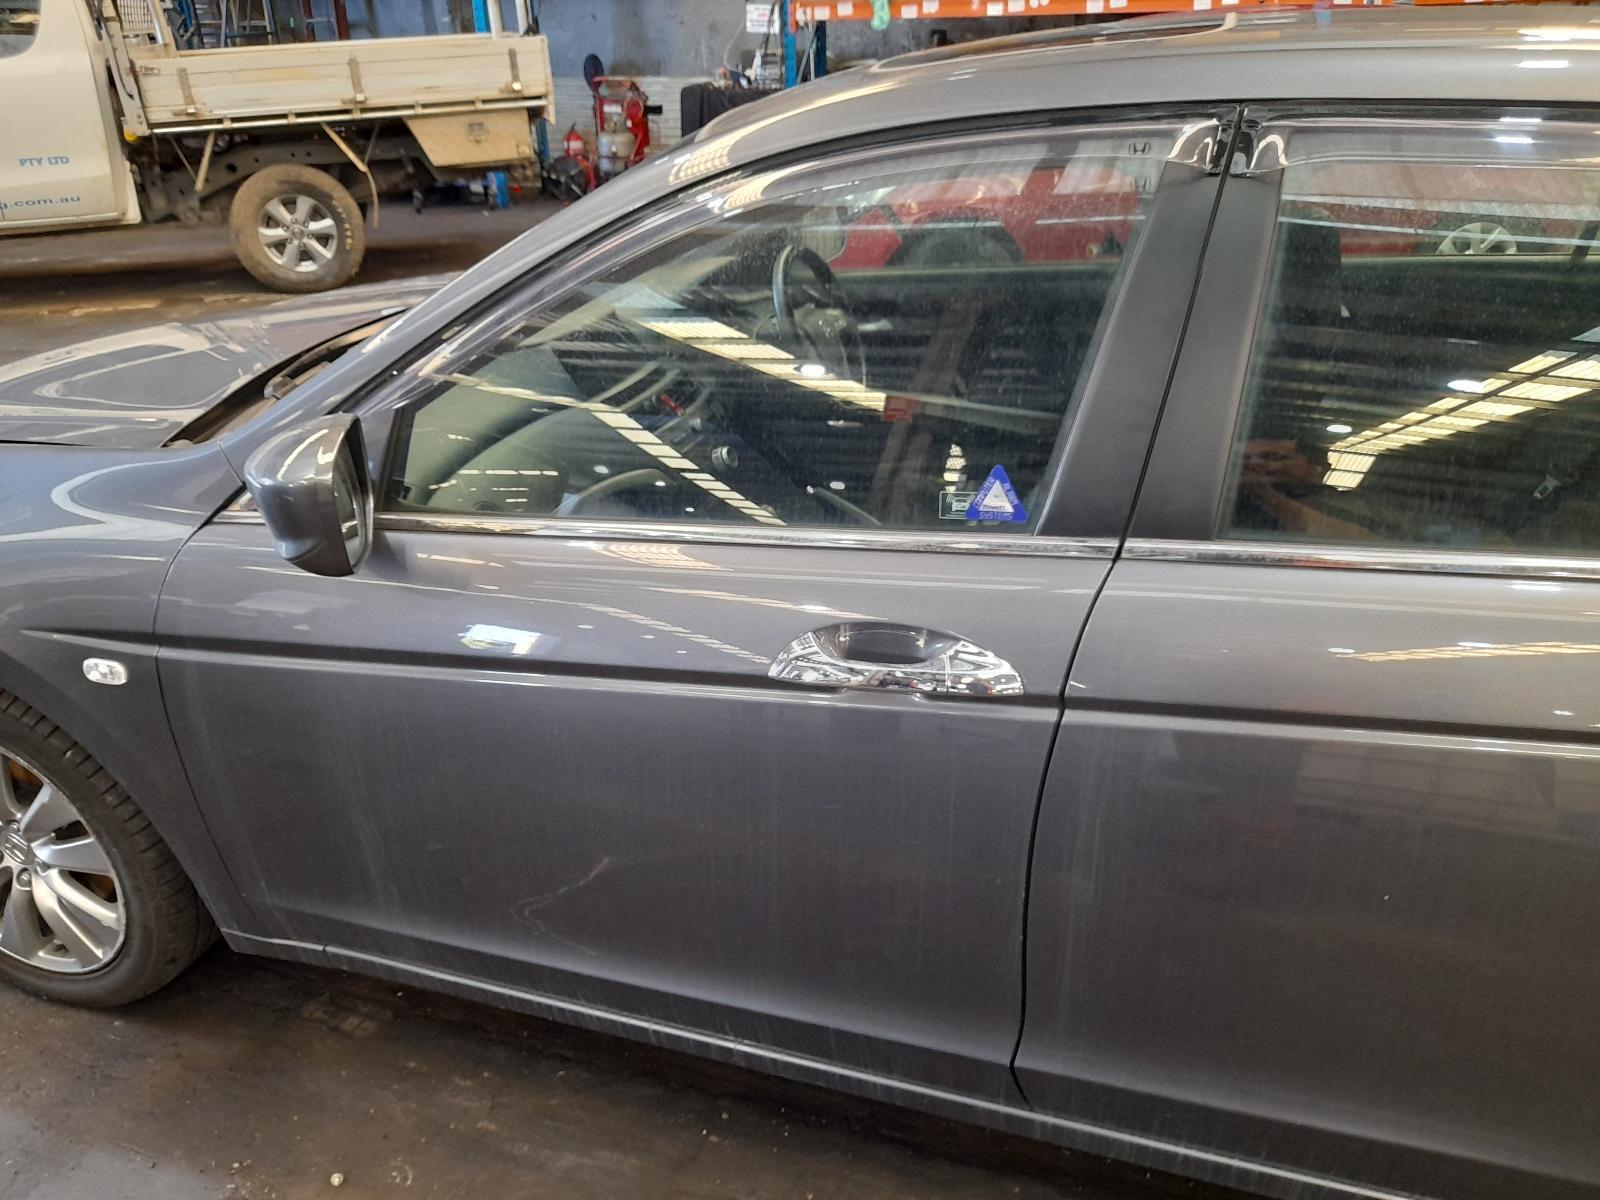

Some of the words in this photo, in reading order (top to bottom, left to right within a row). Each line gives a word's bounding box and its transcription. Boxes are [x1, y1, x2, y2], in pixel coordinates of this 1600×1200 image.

[19, 157, 43, 167] PTY
[48, 156, 70, 165] LTD
[973, 476, 996, 509] COMPUTER
[979, 511, 1013, 520] SYSTEMS
